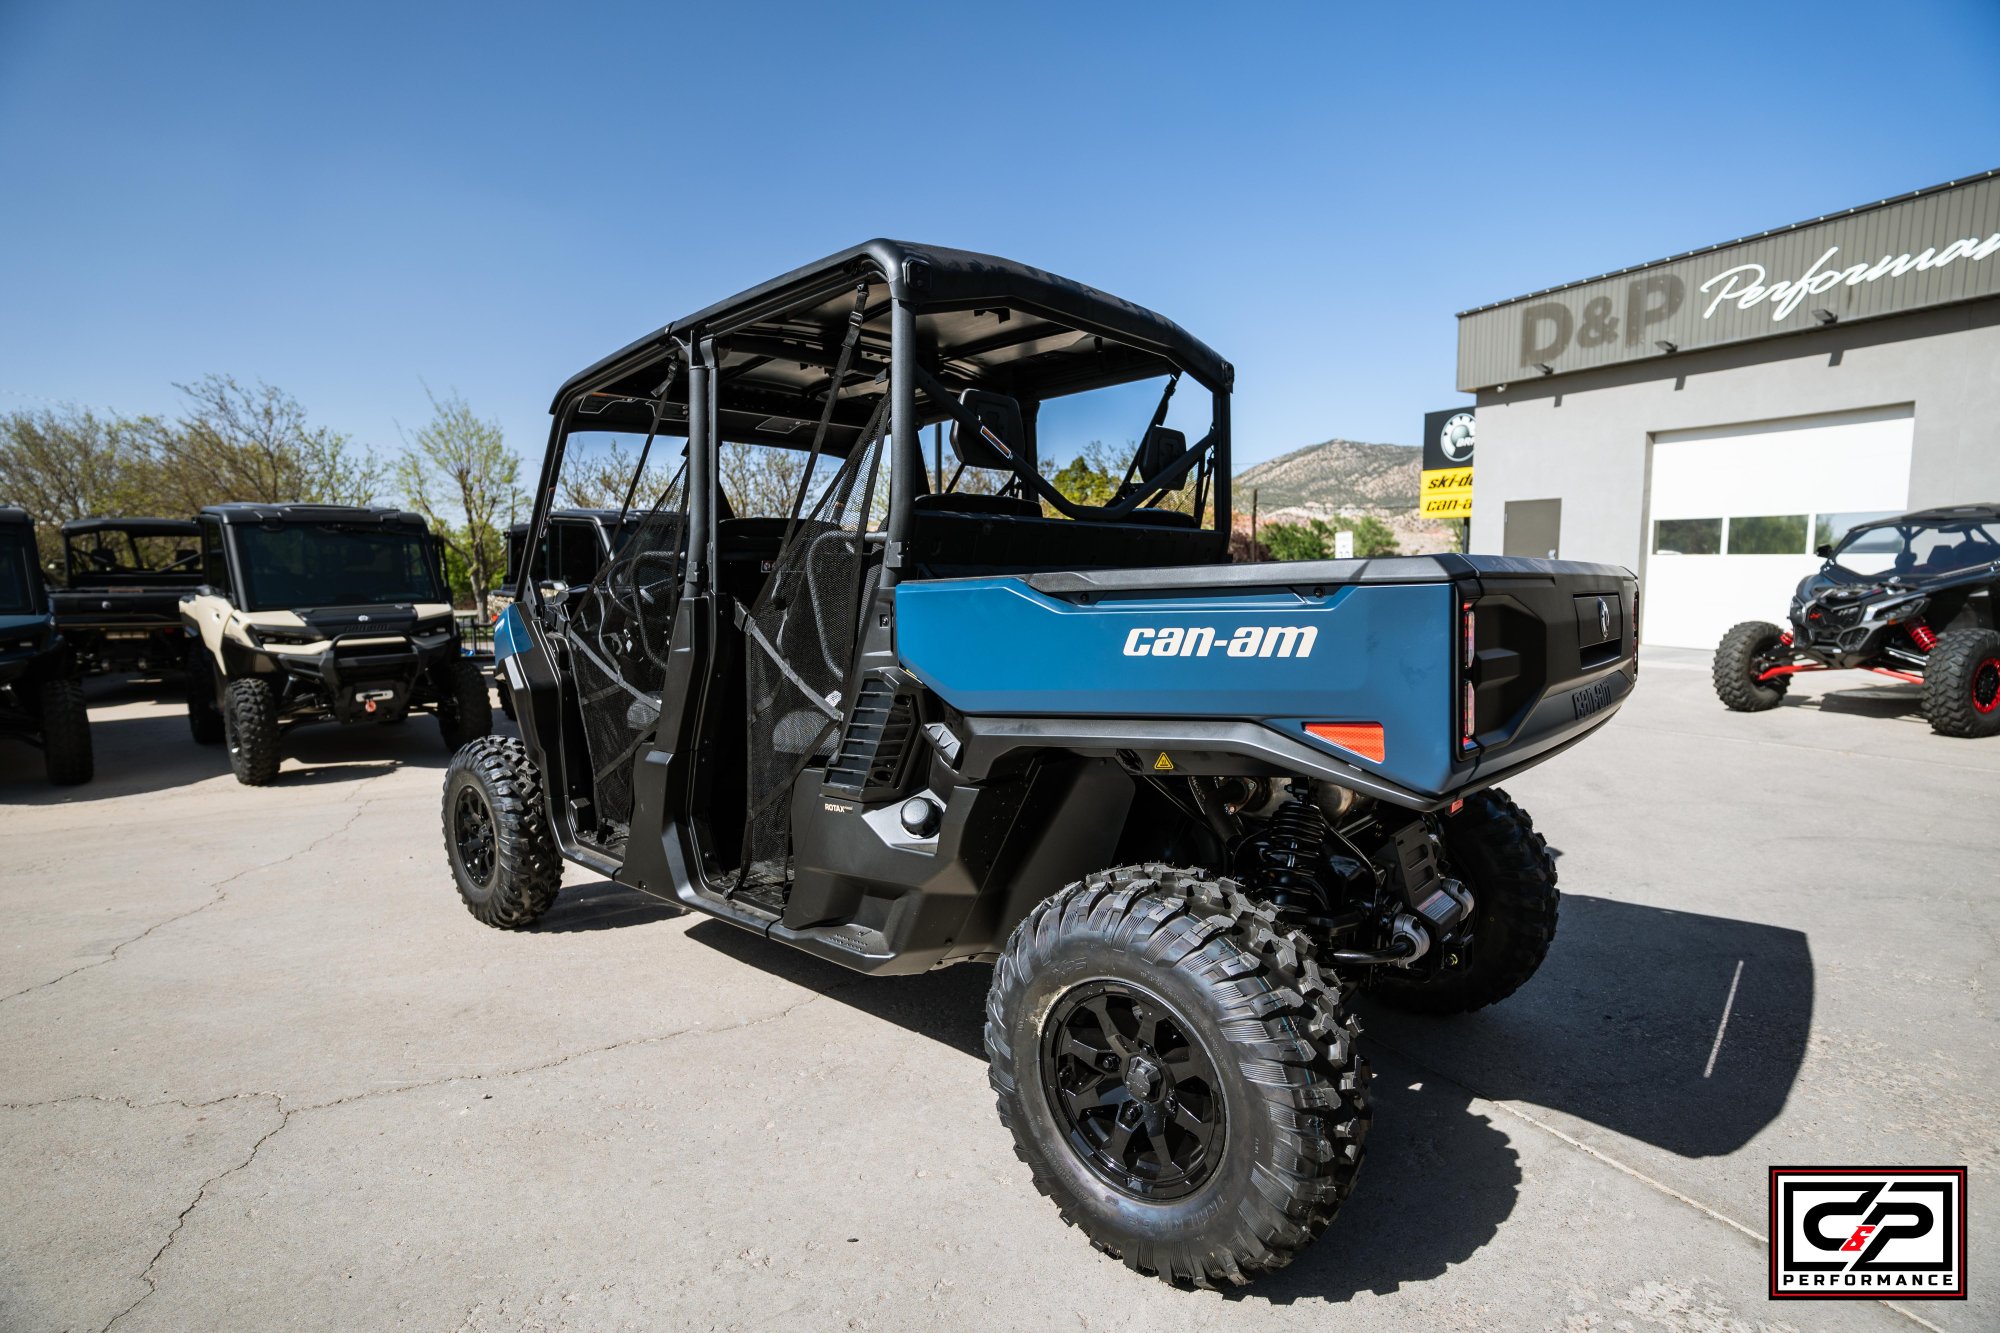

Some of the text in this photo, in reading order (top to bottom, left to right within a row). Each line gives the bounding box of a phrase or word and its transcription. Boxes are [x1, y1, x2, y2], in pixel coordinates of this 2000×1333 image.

[1521, 273, 1684, 367] D&P
[1123, 625, 1319, 658] can-am
[824, 803, 845, 813] ROTAX
